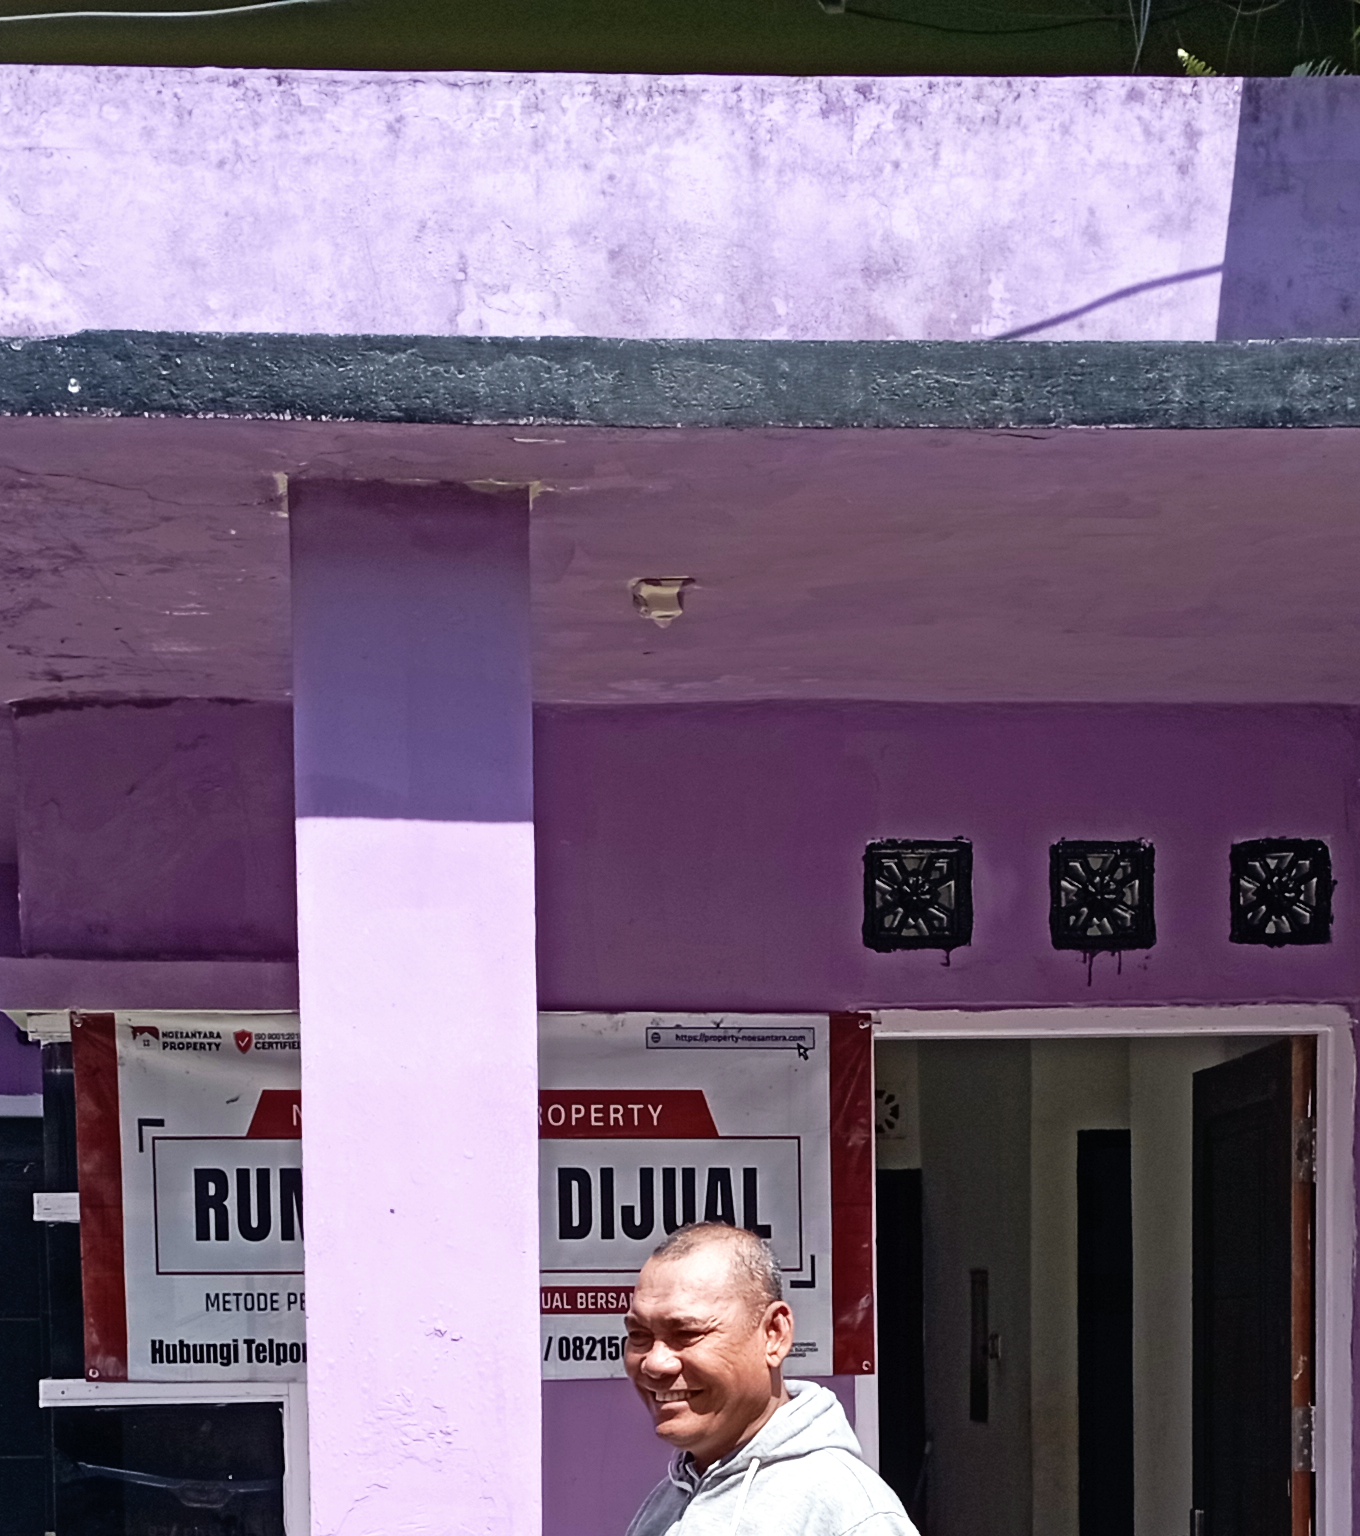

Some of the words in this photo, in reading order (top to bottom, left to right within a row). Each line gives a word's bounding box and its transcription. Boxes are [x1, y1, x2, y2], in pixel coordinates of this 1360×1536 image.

[162, 1041, 222, 1051] PROPERTY
[254, 1040, 301, 1050] CERTIFIE
[539, 1103, 663, 1127] OPERTY
[557, 1167, 772, 1240] DIJUAL
[205, 1292, 280, 1312] METODE
[541, 1292, 572, 1309] UAL
[150, 1338, 239, 1367] Hubungi
